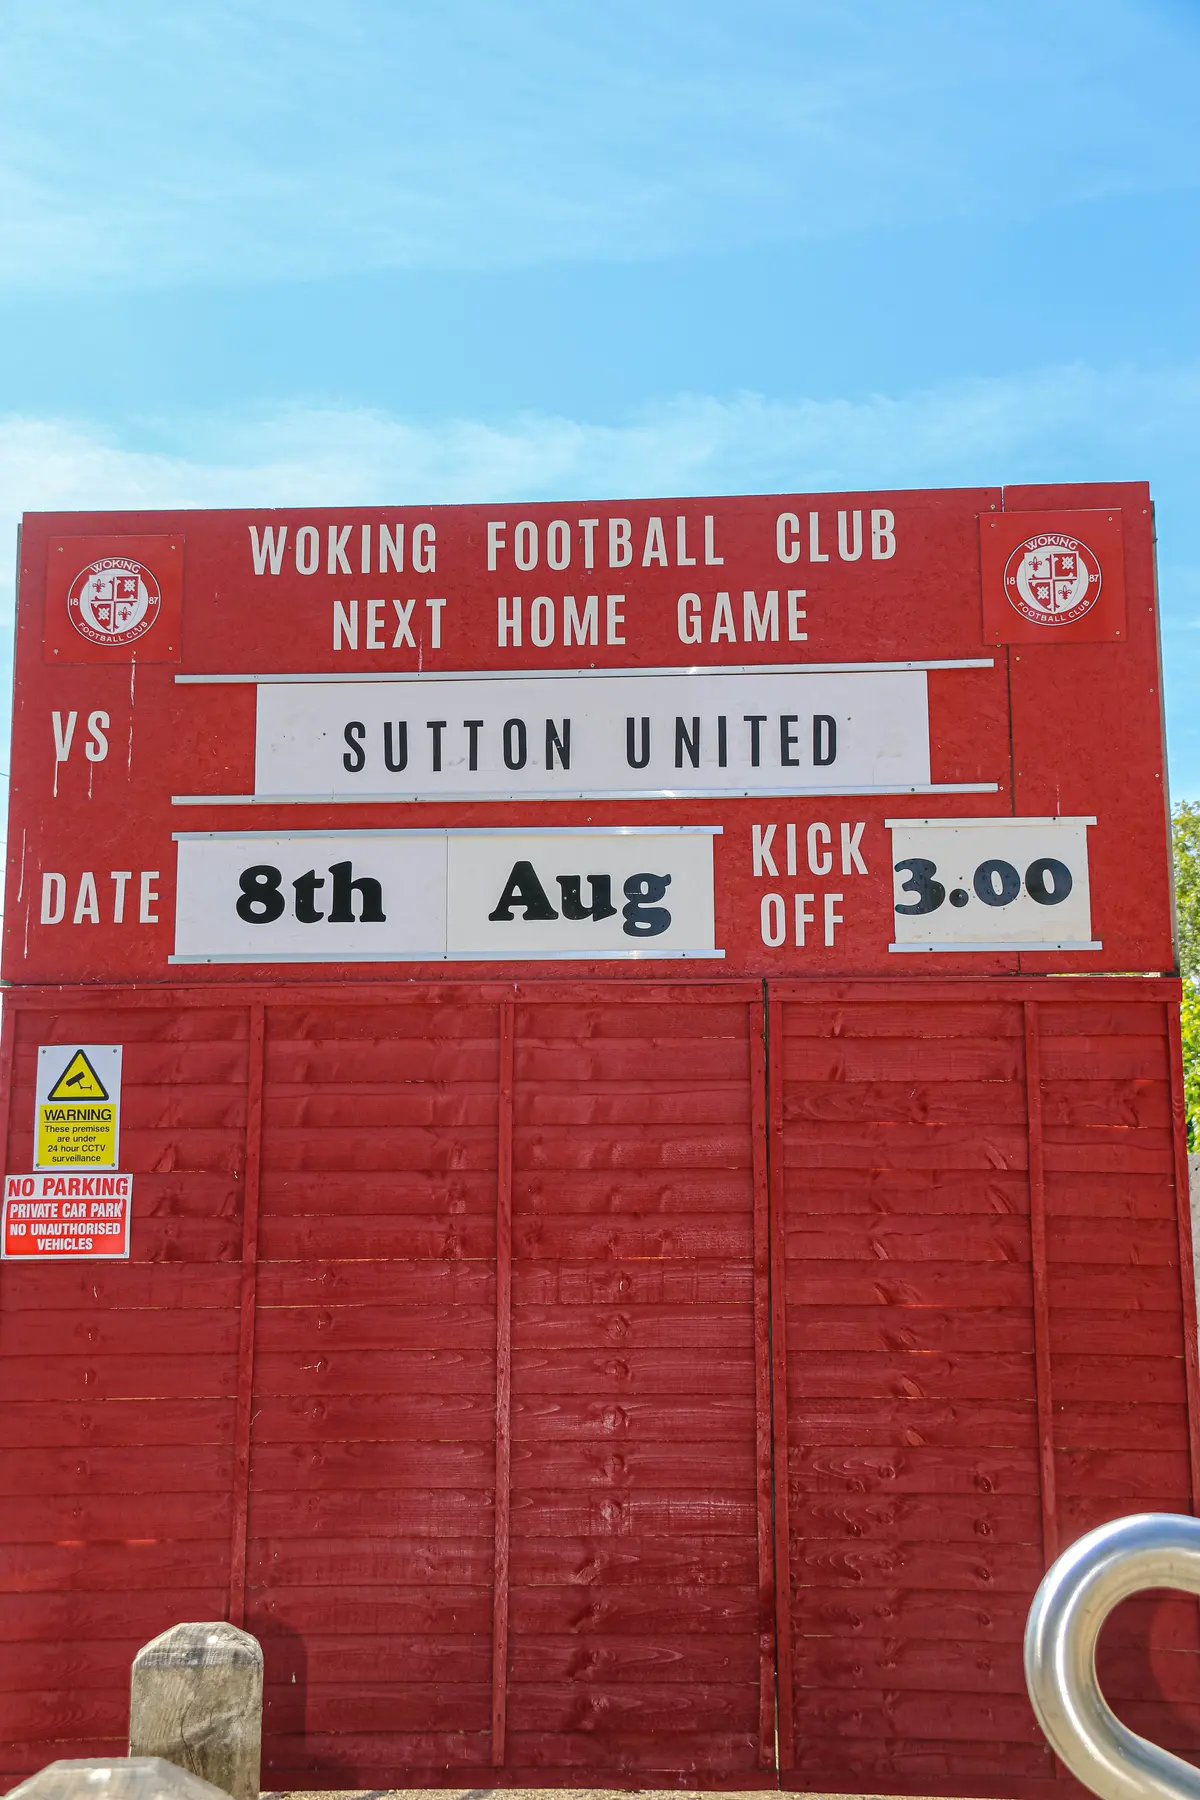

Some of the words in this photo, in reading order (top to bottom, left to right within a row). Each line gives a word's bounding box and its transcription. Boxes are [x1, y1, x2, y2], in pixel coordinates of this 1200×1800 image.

[249, 523, 437, 575] WOKING
[487, 515, 724, 572] FOOTBALL
[776, 509, 897, 563] CLUB
[1025, 536, 1078, 550] WOKING
[90, 559, 141, 574] WOKING
[1007, 577, 1016, 585] 18
[1088, 574, 1099, 583] 87
[70, 598, 79, 606] 18
[148, 596, 159, 605] 87
[1017, 601, 1066, 622] FOOTBALL
[1068, 599, 1090, 618] CLUB
[333, 598, 447, 651] NEXT
[497, 594, 626, 648] HOME
[677, 590, 808, 644] GAME
[78, 622, 124, 643] FOOTBALL
[126, 621, 148, 639] CLUB
[52, 711, 110, 762] VS
[343, 718, 571, 773] SUTTON
[626, 714, 838, 769] UNITED
[752, 821, 868, 877] KICK
[893, 857, 1073, 916] 3.00
[40, 870, 161, 925] DATE
[236, 862, 386, 924] 8th
[488, 860, 672, 938] Aug
[760, 892, 844, 948] OFF
[44, 1108, 112, 1121] WARNING
[72, 1125, 110, 1134] premises
[73, 1135, 97, 1143] under
[47, 1144, 59, 1152] 24
[60, 1144, 80, 1152] hour
[81, 1144, 106, 1152] CCTV
[52, 1154, 101, 1162] surveillance
[8, 1178, 35, 1197] NO
[43, 1177, 129, 1197] PARKING
[9, 1202, 58, 1219] PRIVATE
[62, 1202, 87, 1218] CAR
[91, 1201, 122, 1218] PARK
[10, 1223, 26, 1236] NO
[31, 1222, 121, 1236] UNAUTHORISED
[37, 1237, 93, 1251] VEHICLES
